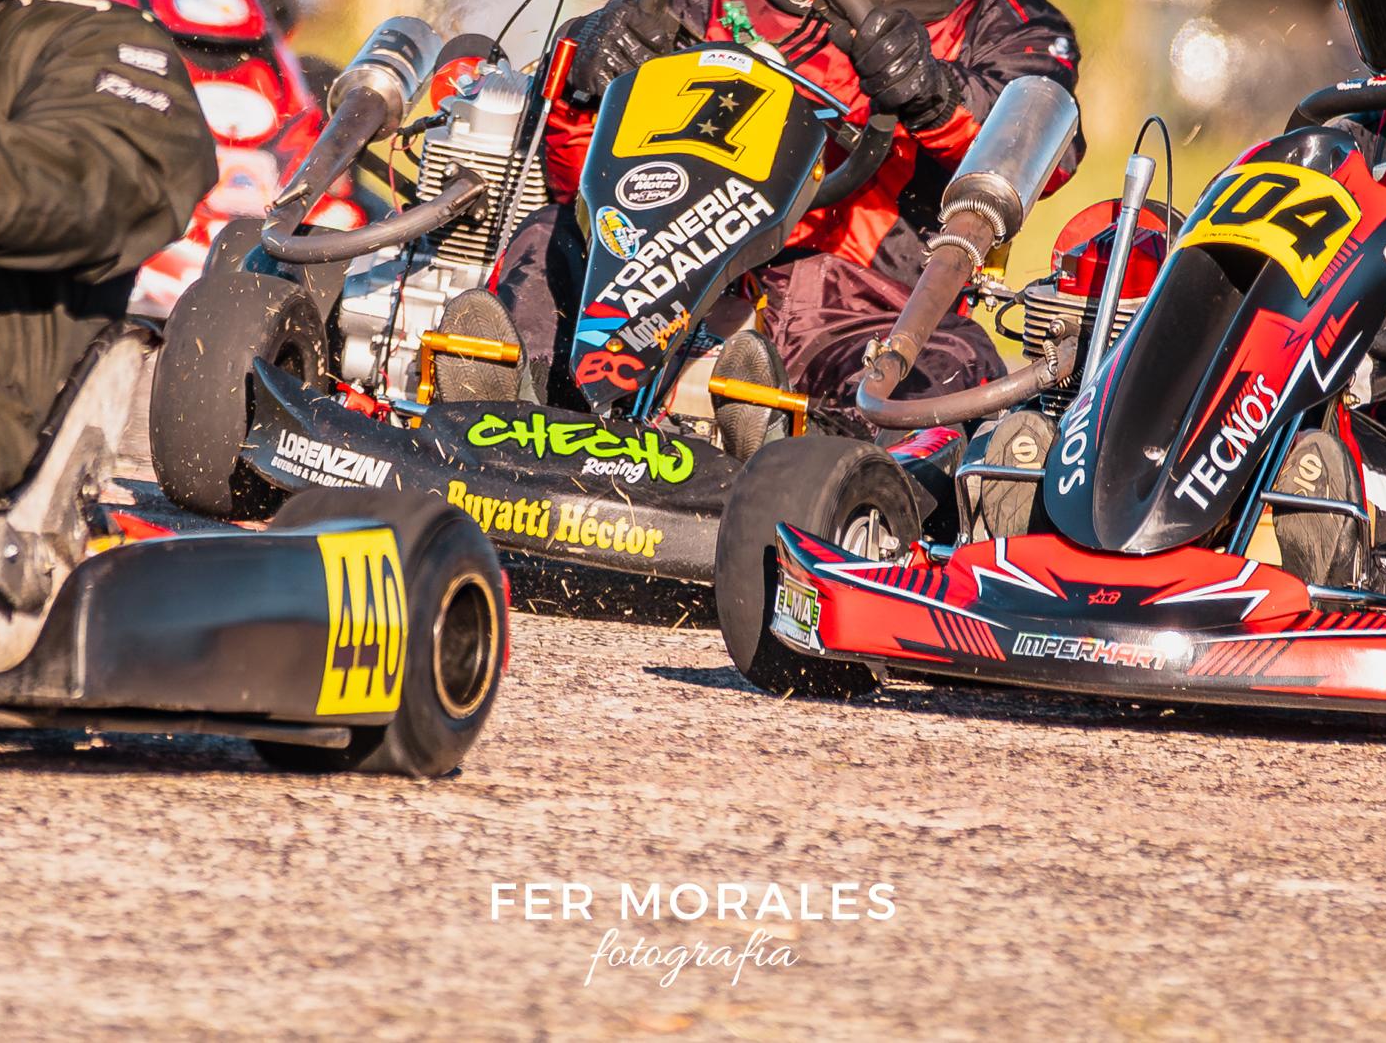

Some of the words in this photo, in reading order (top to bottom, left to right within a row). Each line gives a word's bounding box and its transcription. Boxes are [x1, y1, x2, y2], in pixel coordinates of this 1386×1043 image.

[708, 54, 746, 65] AKNS
[638, 74, 773, 161] 1
[629, 172, 678, 183] Mundo
[634, 181, 678, 191] Motor
[596, 177, 753, 302] TORNERIA
[621, 192, 775, 318] ADALICH
[277, 429, 392, 488] LORENZINI
[468, 414, 693, 483] CHECHO
[581, 458, 647, 483] Racing
[1174, 374, 1278, 510] TECNO'S
[447, 480, 552, 539] Buyatti
[555, 503, 664, 558] Héctor
[332, 555, 403, 698] 440
[782, 585, 812, 626] LMA
[1013, 632, 1169, 670] IMPERKART
